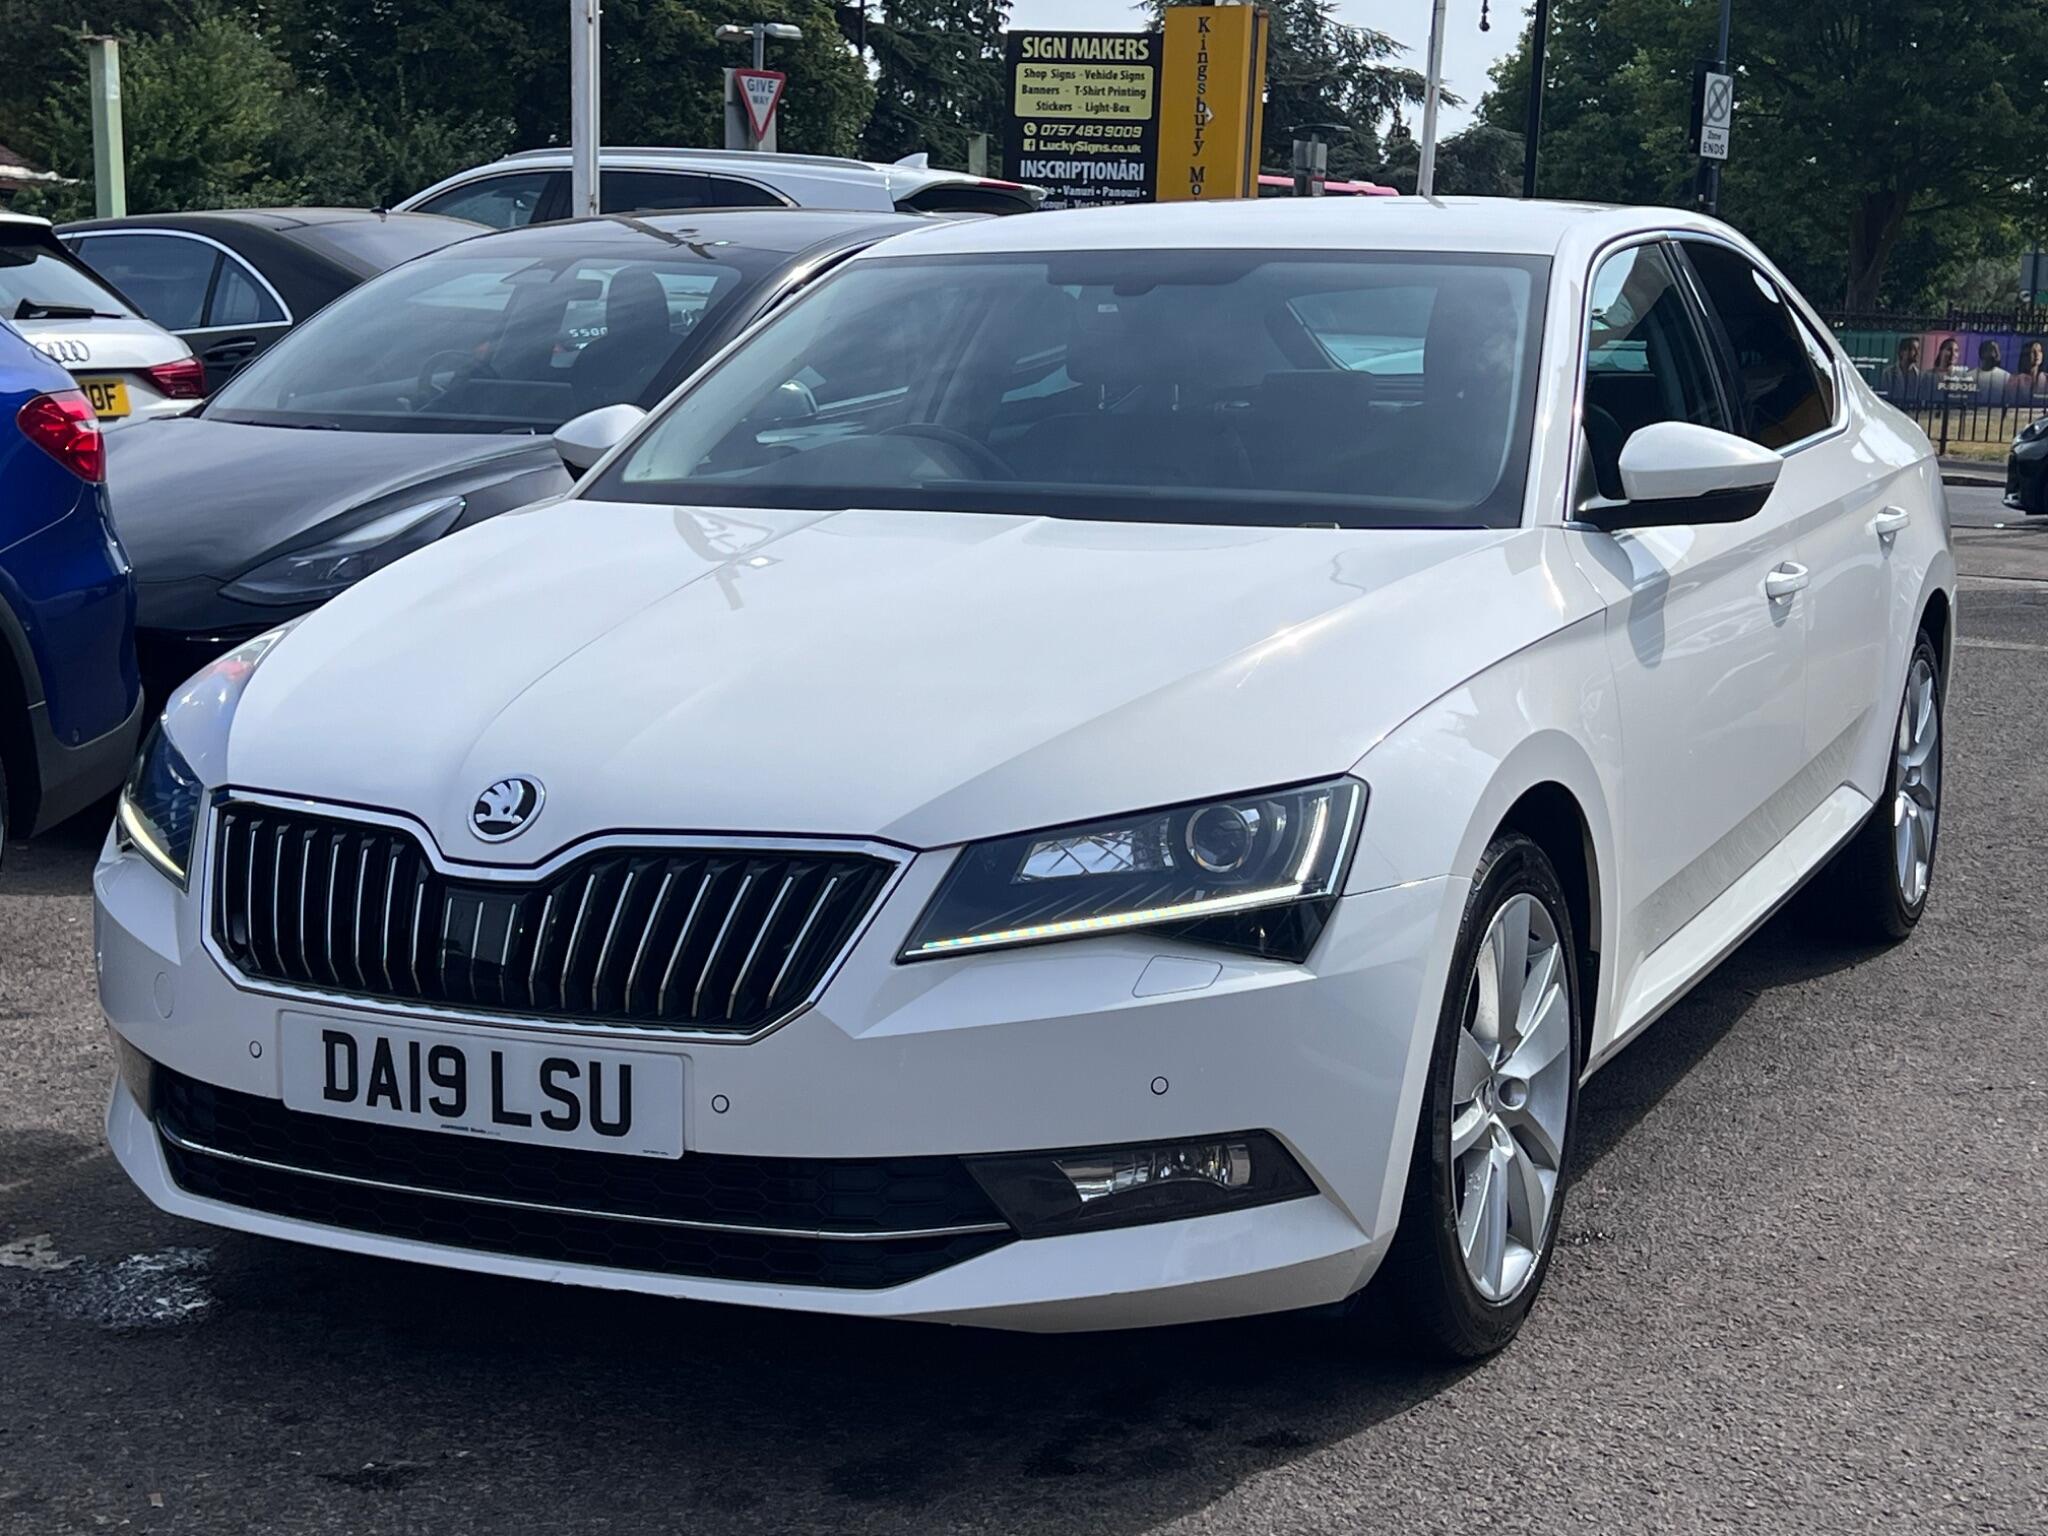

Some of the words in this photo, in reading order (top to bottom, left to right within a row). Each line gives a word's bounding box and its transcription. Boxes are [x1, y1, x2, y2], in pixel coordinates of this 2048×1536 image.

[1021, 36, 1067, 59] SIGN
[1071, 37, 1149, 60] MAKERS
[1023, 67, 1047, 80] Shop
[1050, 68, 1076, 81] Signs
[1084, 69, 1118, 80] Vehicle
[1120, 70, 1145, 83] Signs
[747, 78, 774, 93] GIVE
[1022, 84, 1060, 95] Banners
[1075, 85, 1106, 97] T-Shirt
[1107, 86, 1147, 100] Printing
[1192, 16, 1211, 156] Kingsbury
[752, 96, 770, 105] WAY
[1035, 101, 1073, 112] Stickers
[1085, 102, 1131, 115] Light-Box
[1039, 140, 1142, 155] LuckySigns.co.uk
[1703, 141, 1725, 156] ENDS
[1189, 166, 1205, 200] Mo
[321, 1028, 467, 1118] DA19
[491, 1050, 632, 1137] LSU
